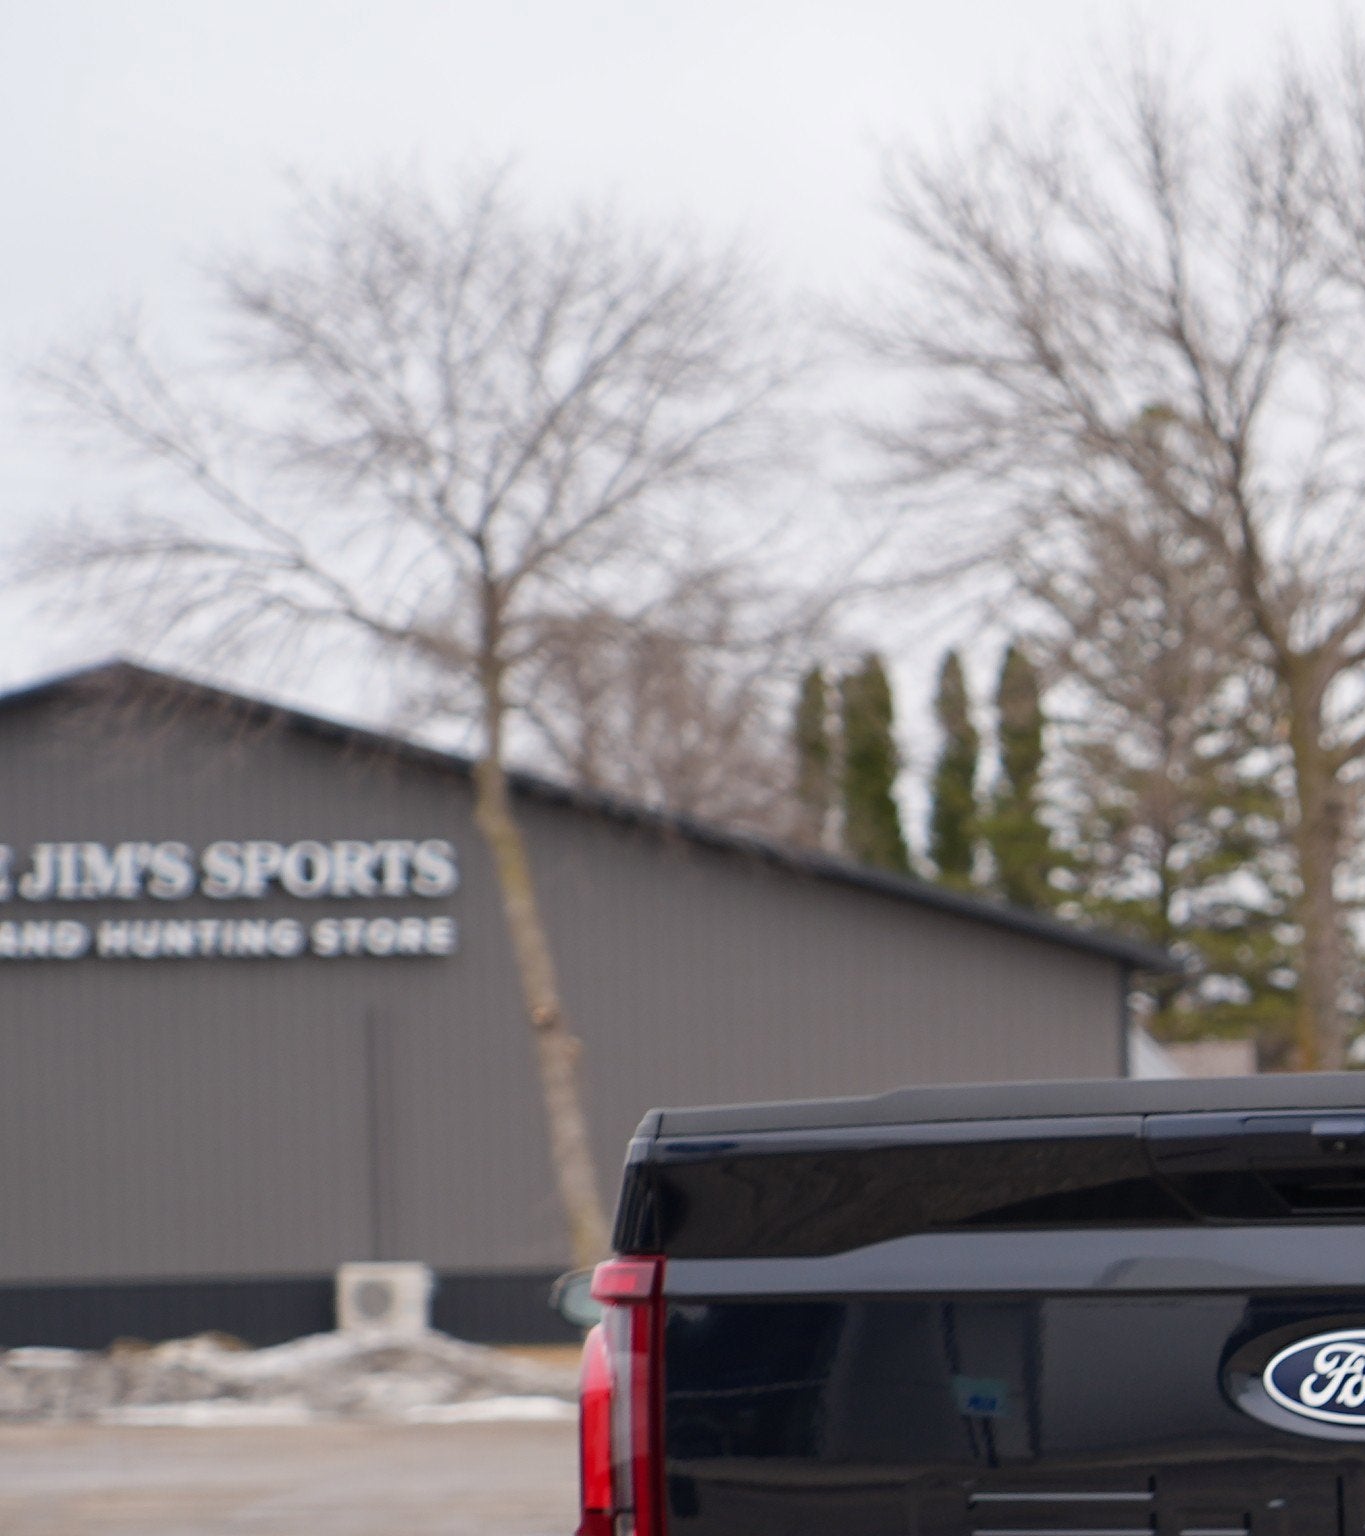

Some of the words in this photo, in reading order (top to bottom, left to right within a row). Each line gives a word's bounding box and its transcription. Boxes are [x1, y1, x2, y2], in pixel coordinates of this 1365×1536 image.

[18, 840, 195, 900] JIM'S
[202, 839, 459, 899] SPORTS
[97, 917, 303, 958] HUNTING
[310, 916, 458, 957] STORE
